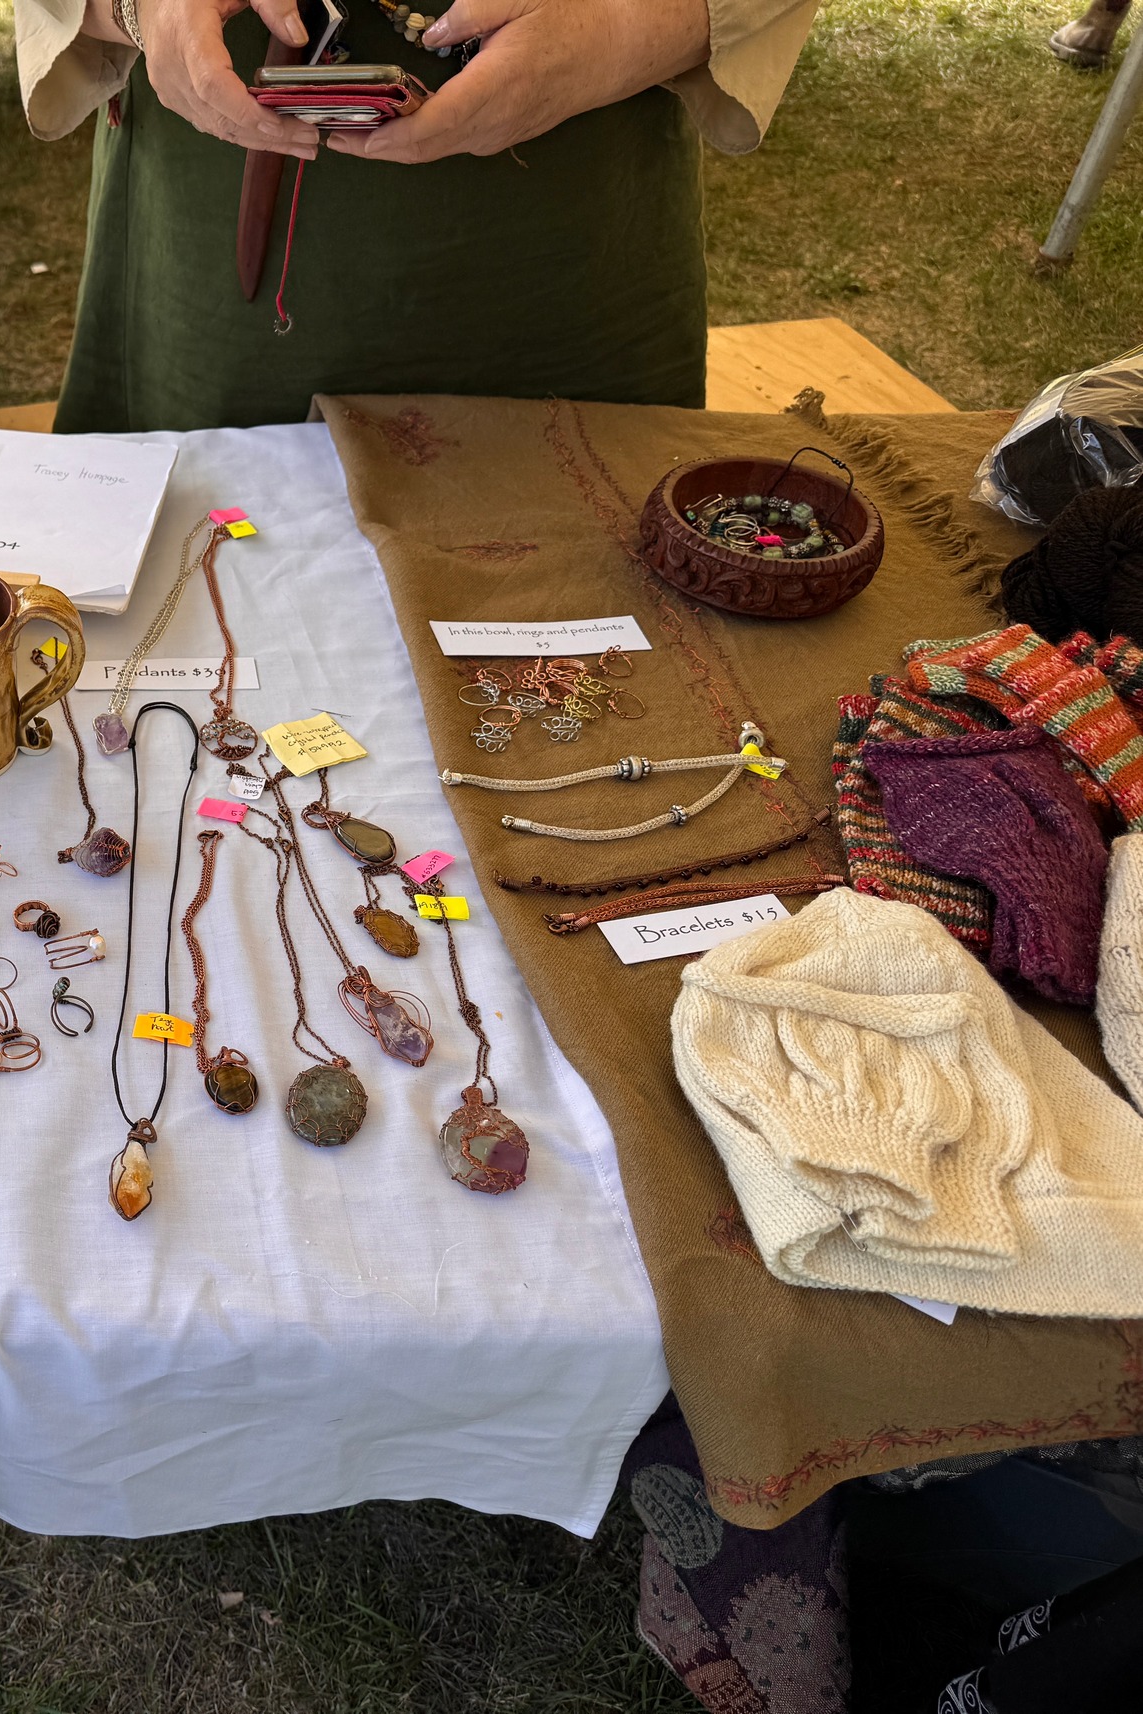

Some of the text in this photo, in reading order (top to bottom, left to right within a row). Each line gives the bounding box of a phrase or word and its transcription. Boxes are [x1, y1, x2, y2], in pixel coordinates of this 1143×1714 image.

[34, 463, 70, 481] Tracey
[448, 623, 625, 638] In this bowl, rings and pendants
[192, 667, 227, 679] $30
[632, 906, 779, 944] Bracelets $15
